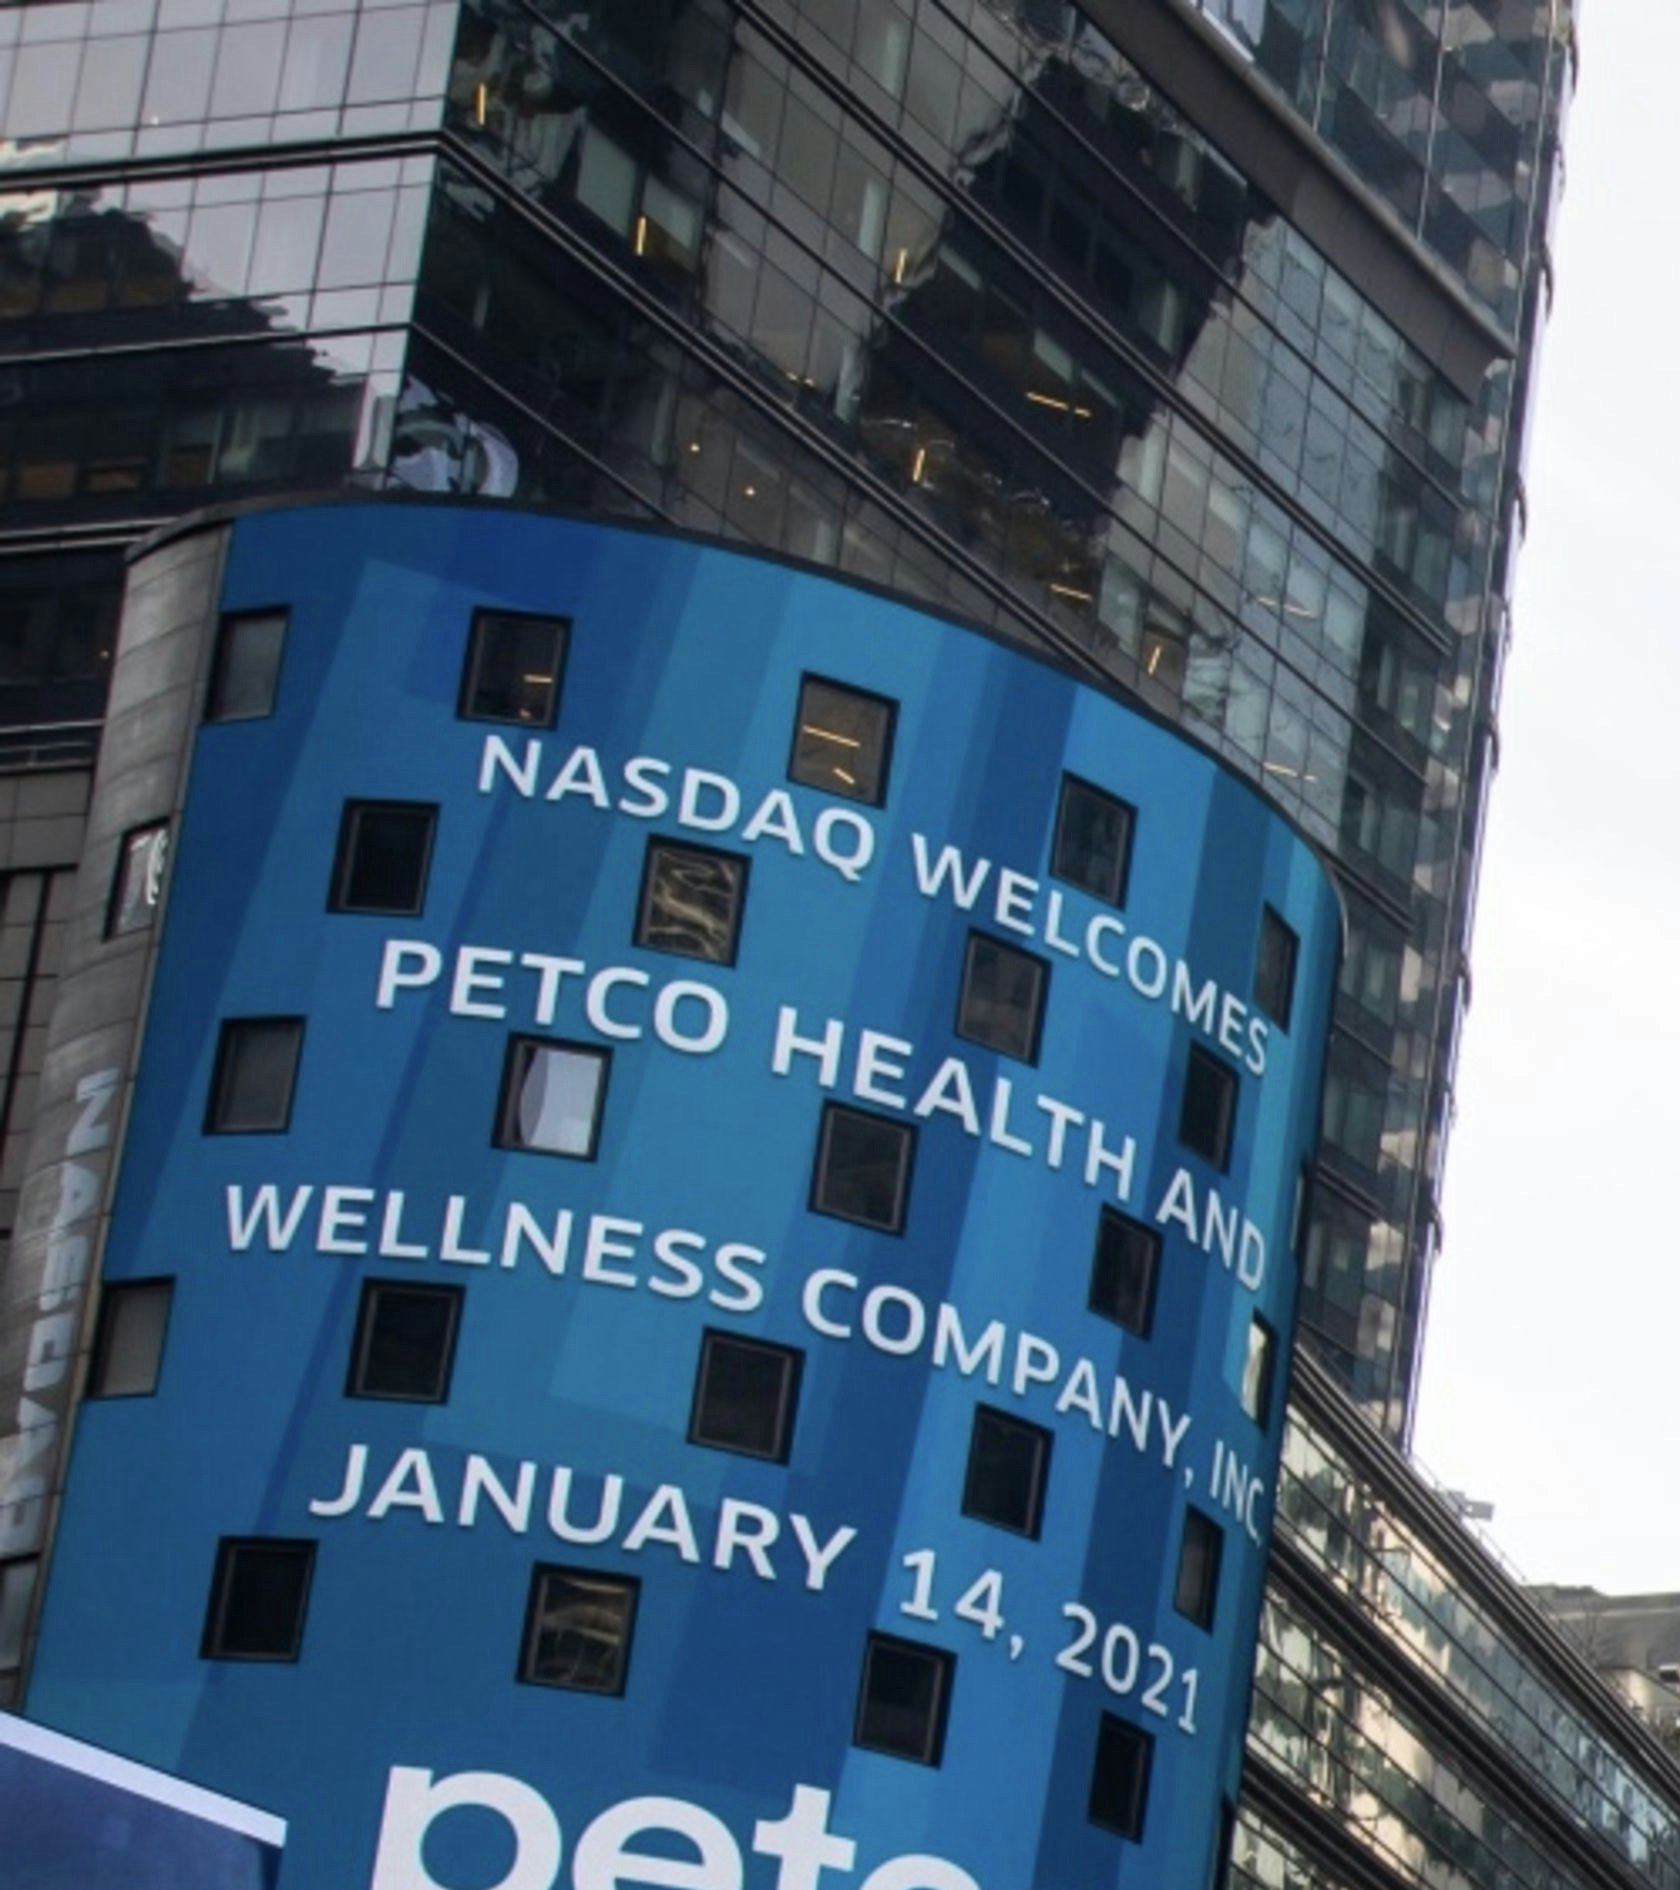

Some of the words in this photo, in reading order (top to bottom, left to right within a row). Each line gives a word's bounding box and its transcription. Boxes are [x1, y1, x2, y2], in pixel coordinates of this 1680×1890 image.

[479, 734, 875, 881] NASDAQ
[911, 832, 1269, 1076] WELCOMES
[375, 939, 728, 1056] PETCO
[772, 1007, 1134, 1201] HEALTH
[1157, 1166, 1266, 1291] AND
[225, 1182, 764, 1312] WELLNESS
[802, 1268, 1196, 1486] COMPANY,
[310, 1444, 857, 1593] JANUARY
[899, 1549, 1025, 1661] 14,
[1053, 1606, 1202, 1735] 2021
